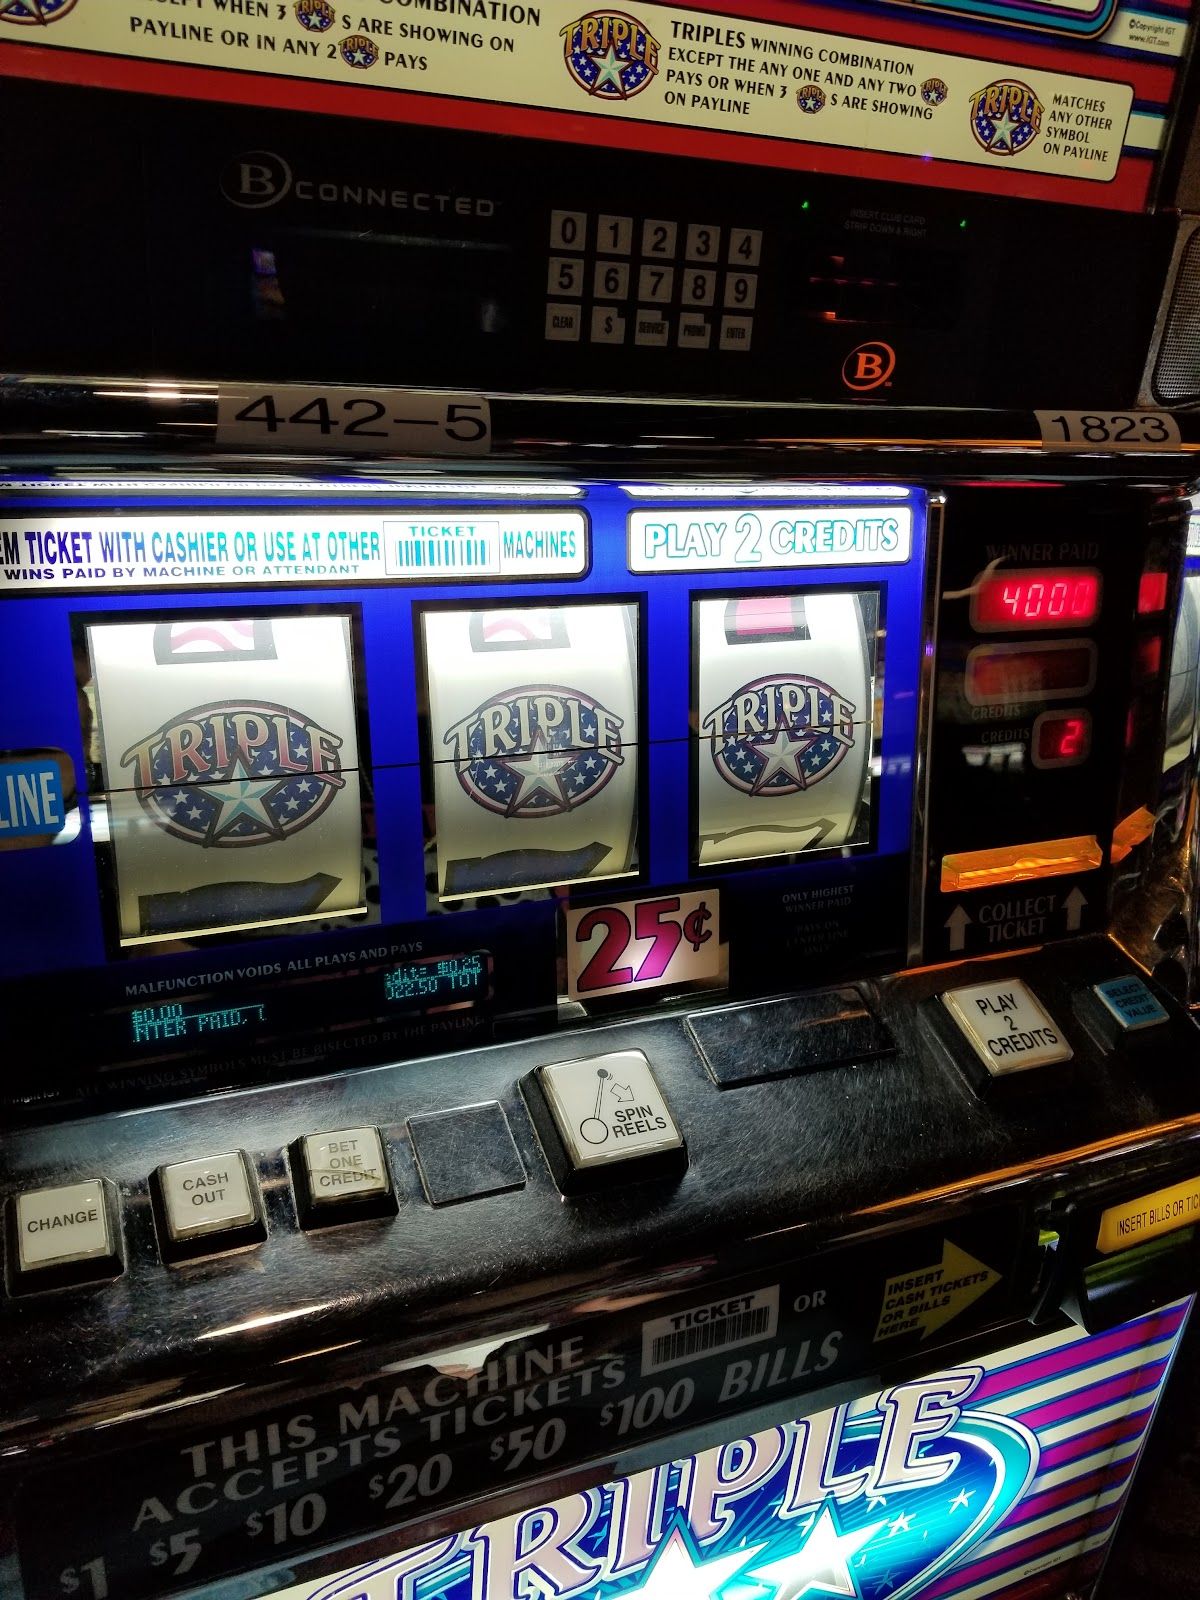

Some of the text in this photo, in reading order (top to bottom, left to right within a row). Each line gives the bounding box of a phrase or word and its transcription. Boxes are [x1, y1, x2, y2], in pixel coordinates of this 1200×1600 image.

[214, 0, 269, 18] WHEN
[276, 4, 287, 20] 3
[342, 15, 351, 30] S
[358, 17, 393, 36] ARE
[399, 22, 483, 48] SHOWING
[489, 36, 515, 53] ON
[130, 16, 428, 71] PAYLINE OR IN ANY 2 PAYS
[559, 15, 661, 75] TRIPLE
[671, 20, 915, 77] TRIPLES WINNING COMBINATION
[668, 46, 917, 98] EXCEPT THE ANY ONE AND ANY TWO
[664, 90, 751, 115] ON PAYLINE
[666, 68, 933, 120] PAYS OR WHEN 3 S ARE SHOWING
[1052, 93, 1106, 113] MATCHES
[969, 84, 1046, 134] TRIPLE
[1049, 109, 1113, 131] ANY OTHER
[1046, 126, 1090, 144] SYMBOL
[1043, 142, 1109, 163] ON PAYLINE
[295, 181, 494, 217] CONNECTED
[561, 217, 753, 260] 0 1 2 3 4
[558, 263, 749, 303] 5 6 7 8 9
[604, 316, 613, 335] $
[1051, 415, 1170, 443] 1823
[24, 525, 577, 566] TICKET WITH CASHIER OR USE AT OTHER TICKET MACHINES
[644, 512, 899, 563] PLAY 2 CREDITS
[4, 564, 360, 581] WINS PAID BY MACHINE OR ATTENDANT
[702, 682, 856, 755] TRIPLE
[443, 696, 625, 773] TRIPLE
[981, 728, 1030, 744] CREDITS
[1060, 720, 1083, 754] 2
[120, 713, 346, 797] TRIPLE
[811, 885, 854, 899] HIGHEST
[978, 895, 1057, 924] COLLECT
[575, 897, 712, 992] 25¢
[987, 917, 1047, 943] TICKET
[125, 941, 423, 996] MALFUNCTION VOIDS ALL PLAYS AND PAYS
[975, 993, 1018, 1016] PLAY
[1003, 1015, 1018, 1031] 2
[987, 1027, 1058, 1058] CREDITS
[612, 1117, 667, 1138] REELS
[614, 1105, 654, 1123] SPIN
[328, 1139, 358, 1154] BET
[329, 1154, 362, 1169] ONE
[182, 1172, 229, 1192] CASH
[319, 1168, 377, 1188] CREDIT
[191, 1188, 226, 1206] OUT
[27, 1208, 99, 1234] CHANGE
[1116, 1194, 1200, 1237] INSERT BILLS OR TIC
[885, 1270, 989, 1310] CASH TICKETS
[888, 1269, 945, 1295] INSERT
[882, 1295, 951, 1324] OR BILLS
[878, 1316, 920, 1338] HERE
[132, 1289, 827, 1534] ACCEPTS TICKETS TICKET OR
[181, 1335, 586, 1478] THIS MACHINE
[60, 1330, 843, 1600] $1 $5 $10 $20 $50 $100 BILLS
